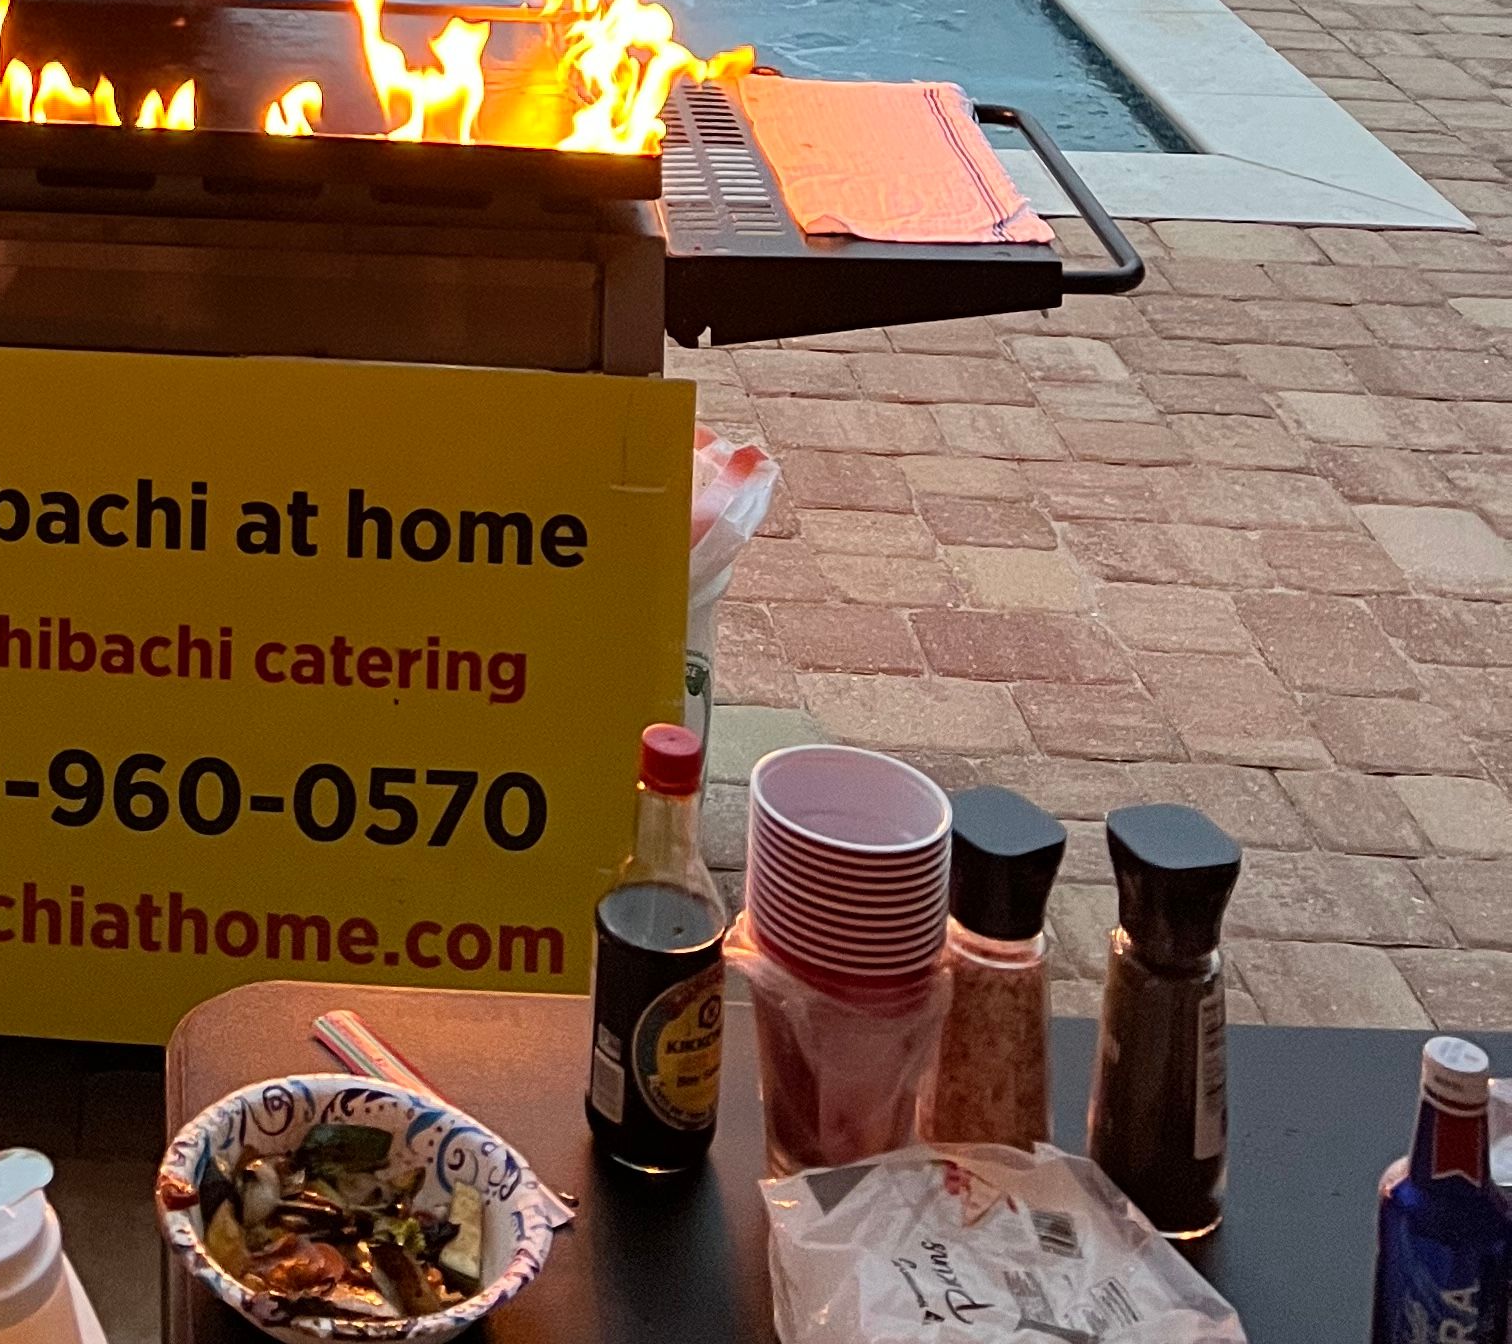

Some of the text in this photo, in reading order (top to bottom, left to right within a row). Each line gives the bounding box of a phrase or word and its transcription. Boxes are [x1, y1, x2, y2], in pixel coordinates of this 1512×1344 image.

[236, 491, 319, 557] at
[347, 488, 588, 568] home
[254, 635, 527, 704] catering
